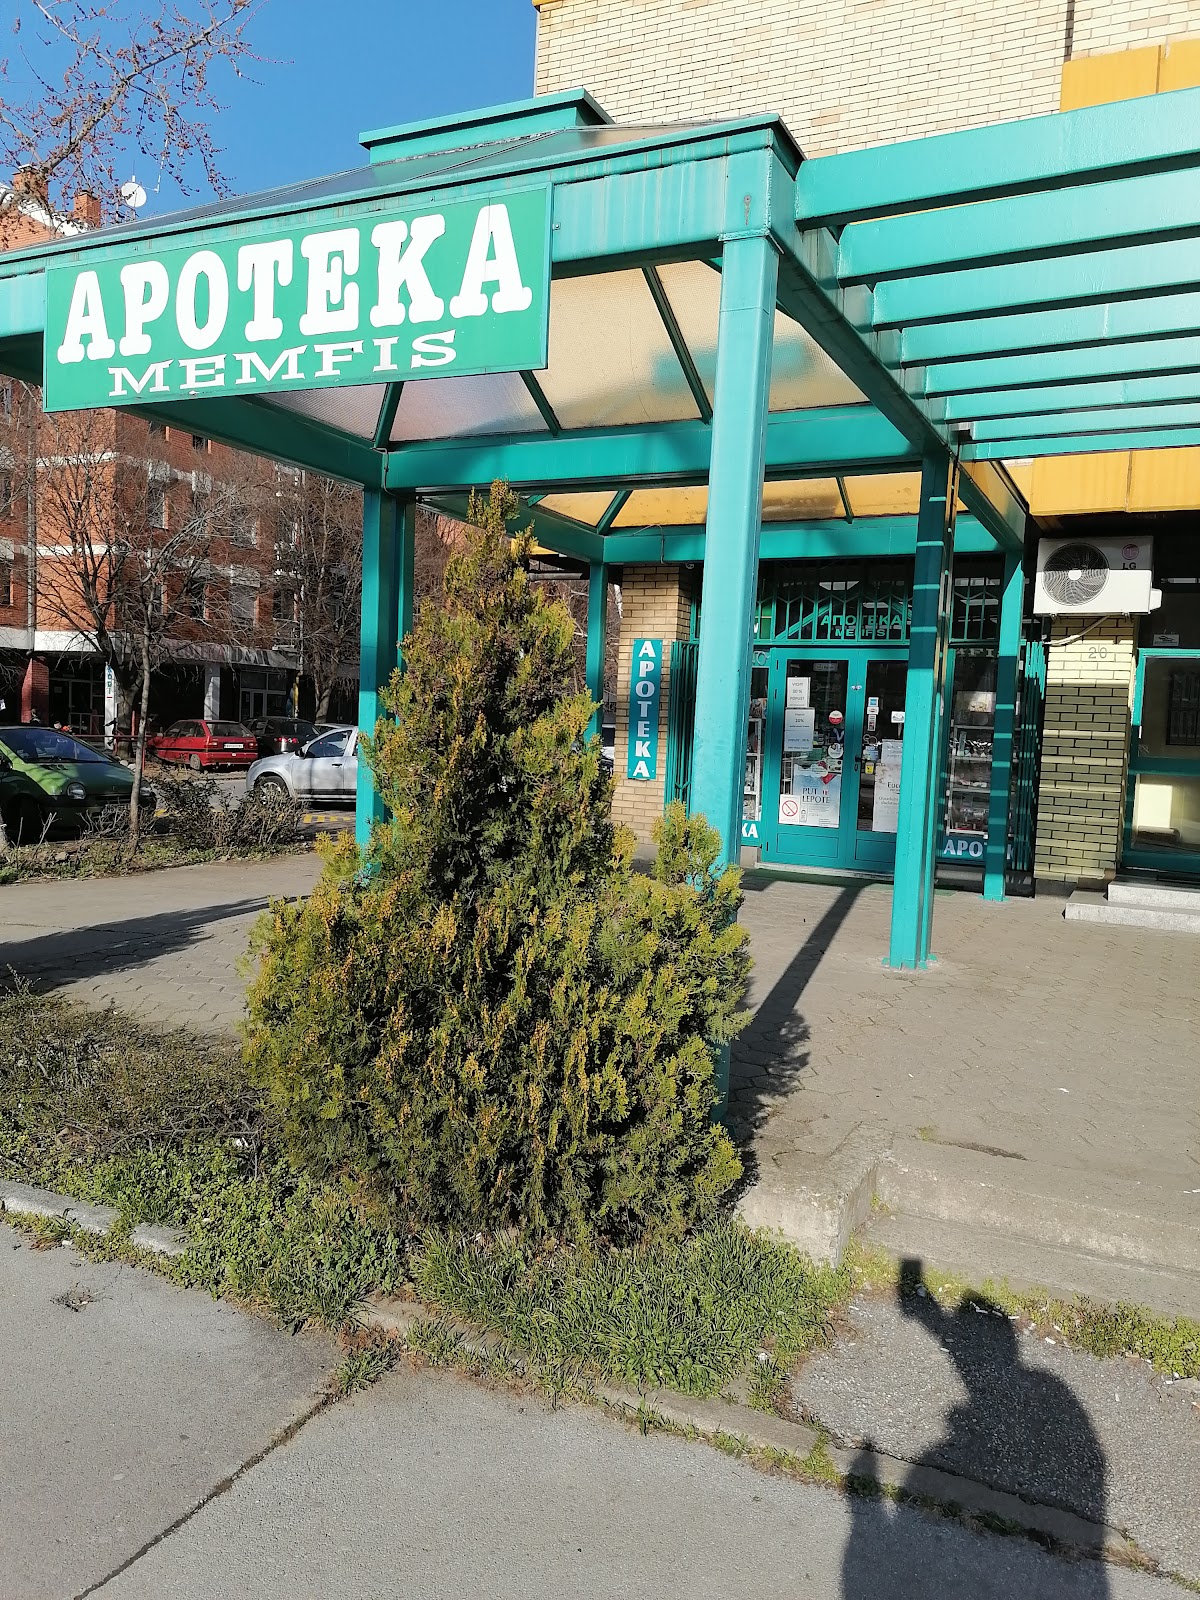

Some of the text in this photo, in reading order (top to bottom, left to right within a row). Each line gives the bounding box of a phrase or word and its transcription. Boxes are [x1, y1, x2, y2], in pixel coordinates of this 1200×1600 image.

[57, 203, 533, 365] APOTEKA
[108, 329, 457, 398] MEMFIS
[1122, 562, 1137, 570] LG
[1088, 646, 1108, 659] 20
[632, 640, 656, 778] APOTEKA
[802, 787, 819, 795] PUT
